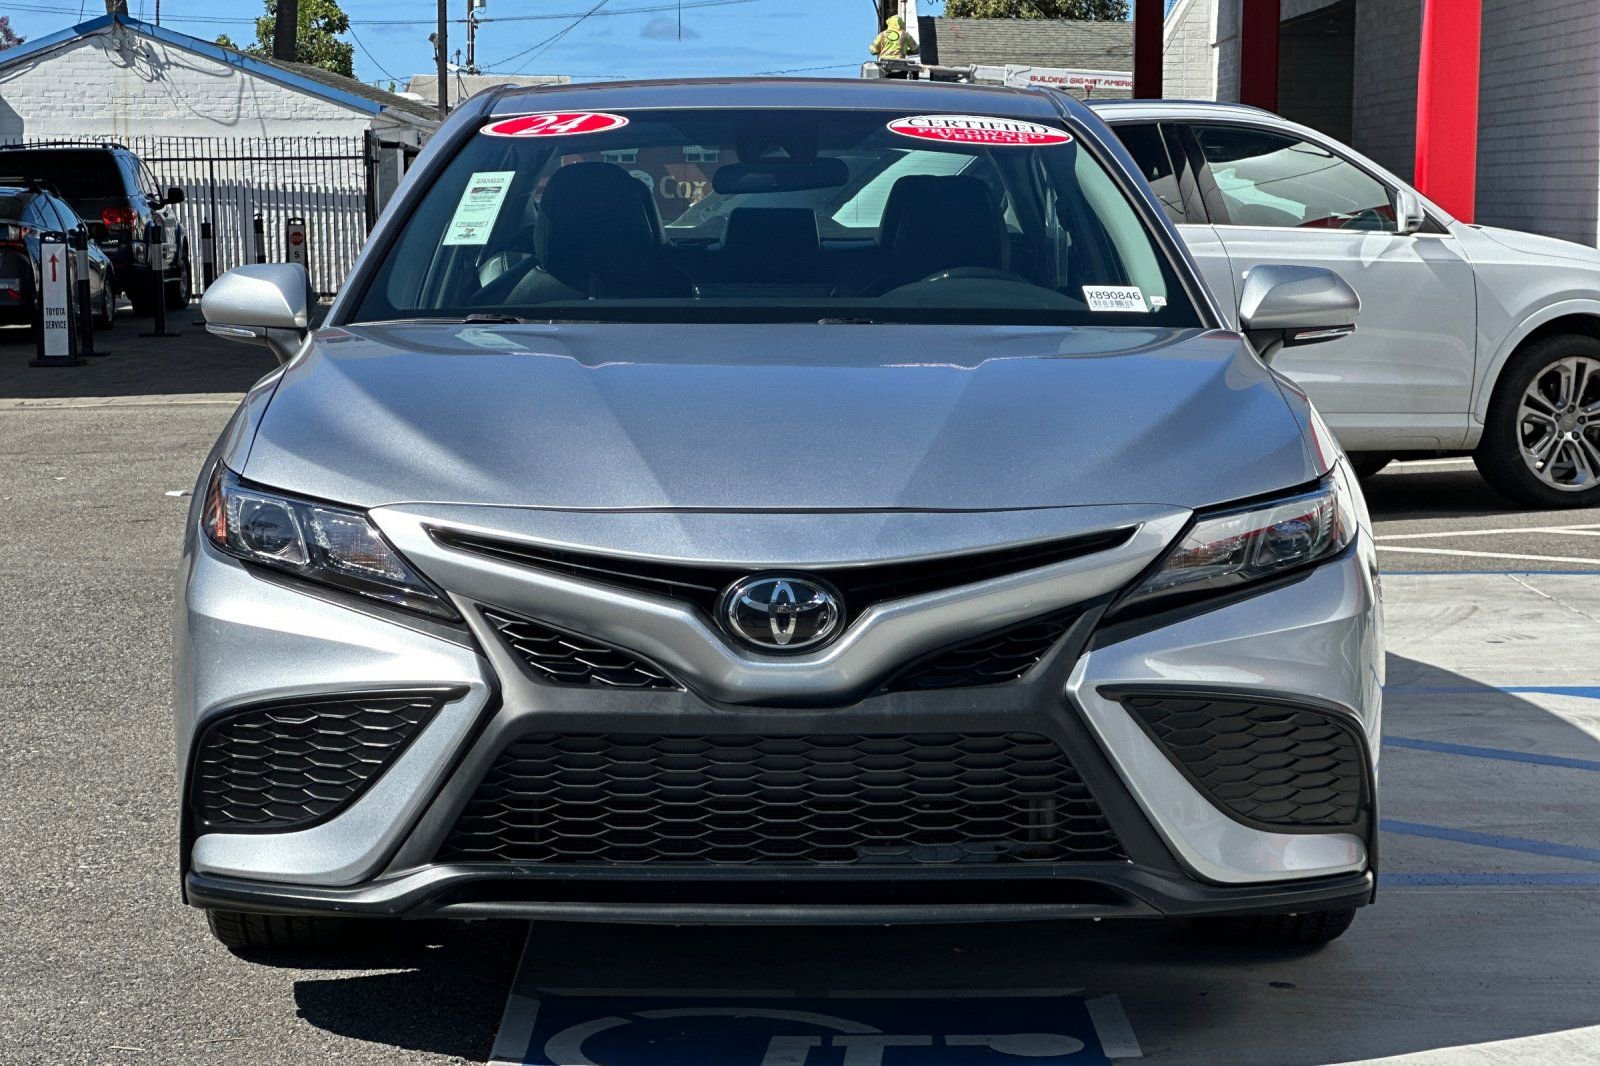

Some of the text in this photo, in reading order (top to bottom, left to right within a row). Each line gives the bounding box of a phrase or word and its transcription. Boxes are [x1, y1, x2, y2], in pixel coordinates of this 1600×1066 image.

[1030, 75, 1067, 84] BUILDING
[1069, 77, 1102, 85] GIGABIT
[511, 114, 594, 134] 24
[908, 118, 1048, 133] CERTIFIED
[918, 128, 1045, 140] PRE-OWNED
[939, 132, 1029, 143] VEHICLE
[1087, 291, 1140, 300] X890846
[45, 307, 66, 316] TOYOTA
[45, 320, 67, 329] SERVICE
